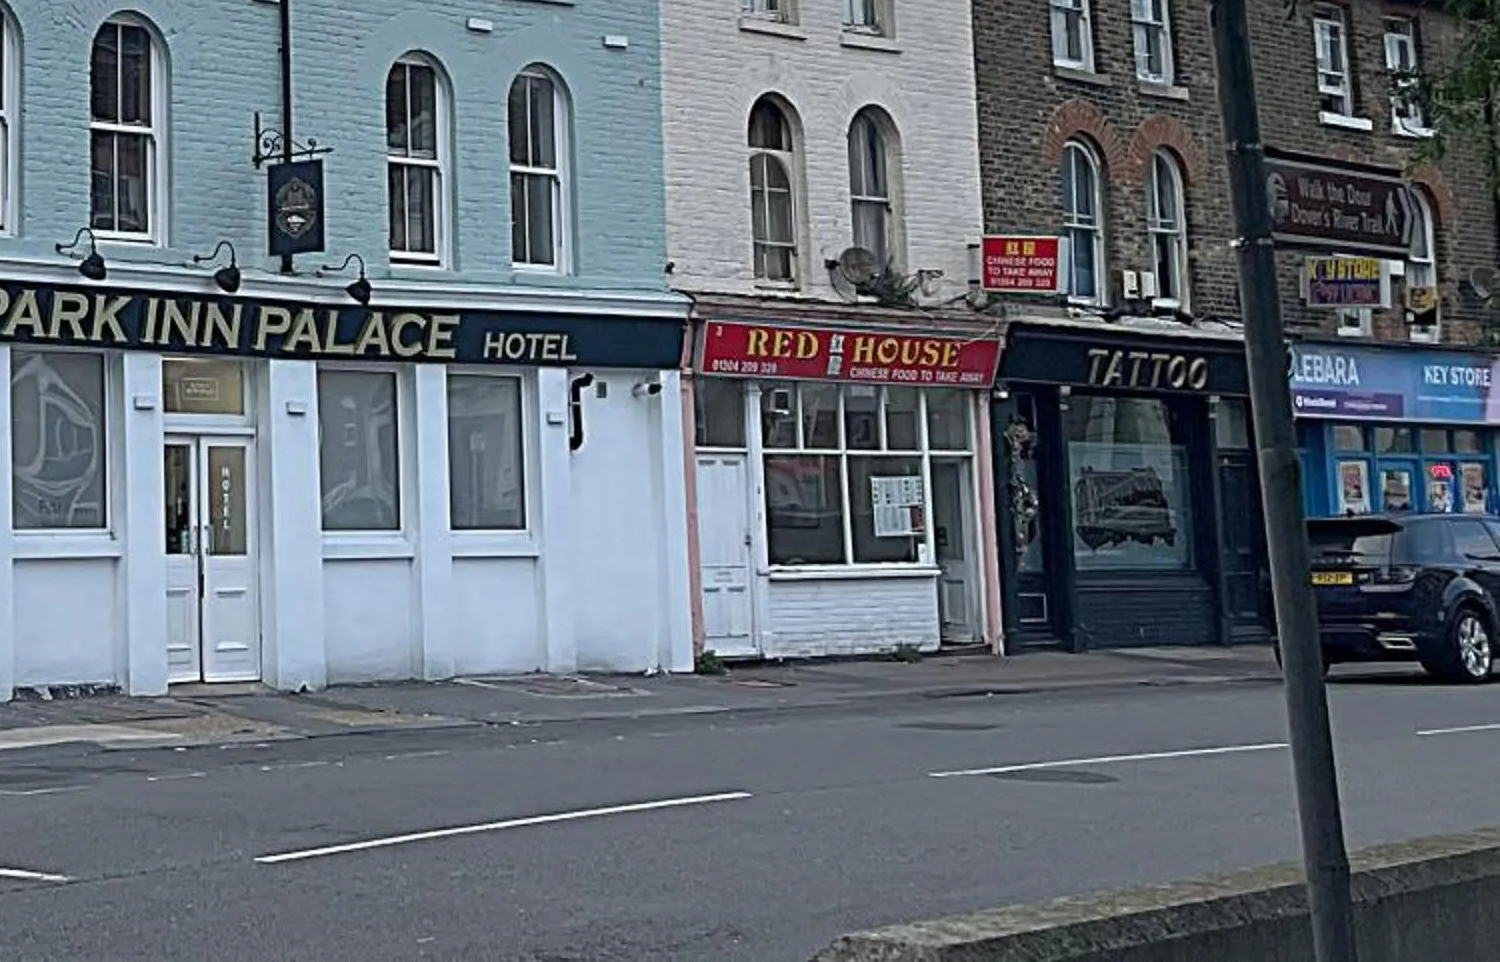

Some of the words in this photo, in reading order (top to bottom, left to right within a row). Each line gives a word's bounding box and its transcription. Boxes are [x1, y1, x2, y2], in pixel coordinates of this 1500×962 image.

[1298, 178, 1323, 199] Walk
[1327, 182, 1345, 202] the
[987, 256, 1027, 267] CHINESE
[1029, 257, 1055, 267] FOOD
[987, 266, 1001, 275] TO
[1003, 267, 1027, 276] TAKE
[1028, 267, 1053, 277] AWAY
[141, 297, 243, 349] INN
[254, 307, 461, 358] PALACE
[484, 331, 577, 362] HOTEL
[746, 329, 819, 359] RED
[851, 337, 960, 367] HOUSE
[849, 366, 889, 379] CHINESE
[891, 369, 918, 381] FOOD
[921, 370, 933, 381] TO
[935, 370, 958, 382] TAKE
[959, 372, 984, 383] AWAY
[1086, 348, 1209, 390] TATTOO
[1295, 354, 1360, 386] LEBARA
[1424, 365, 1449, 385] KEY
[1451, 366, 1492, 387] STORE
[221, 466, 230, 530] HOTEL
